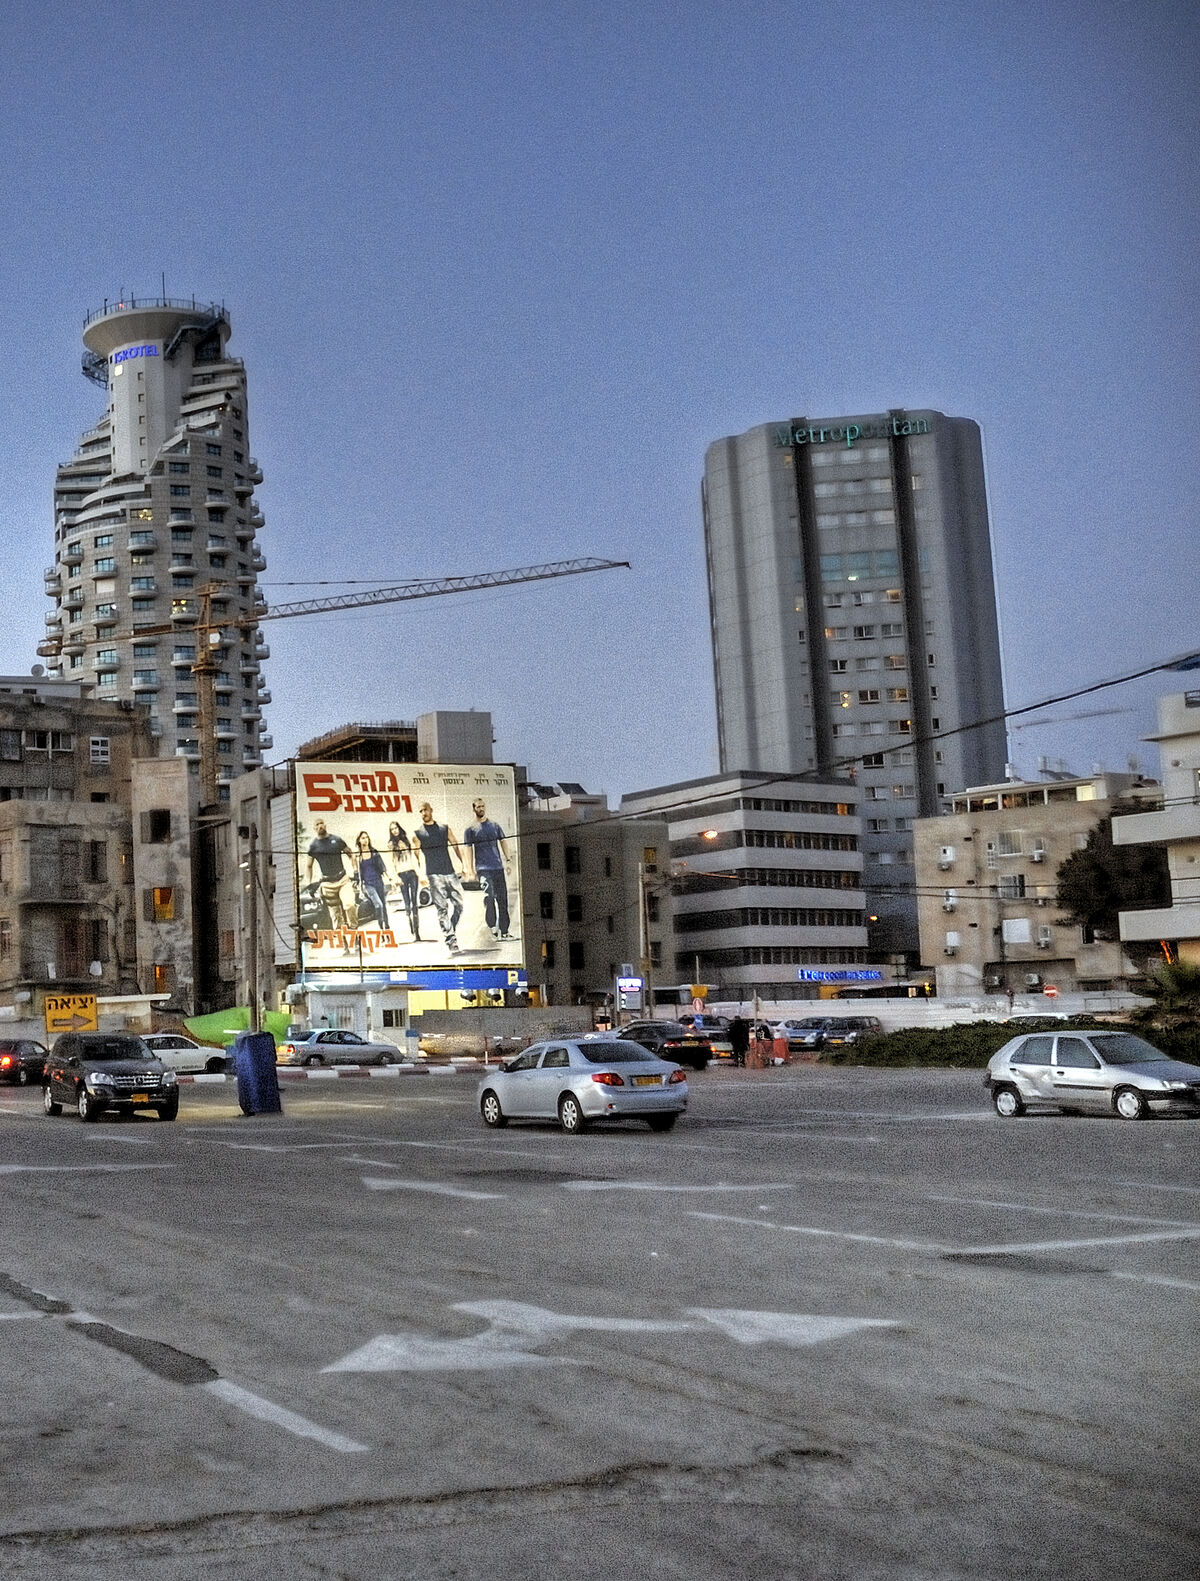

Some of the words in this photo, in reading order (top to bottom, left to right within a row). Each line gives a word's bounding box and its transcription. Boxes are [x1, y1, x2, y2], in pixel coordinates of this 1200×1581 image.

[114, 345, 159, 364] ISROTEL
[775, 417, 928, 447] Metropotan
[335, 770, 399, 792] מהיר
[302, 773, 339, 811] 5
[507, 970, 518, 985] P
[48, 996, 94, 1010] יציאה
